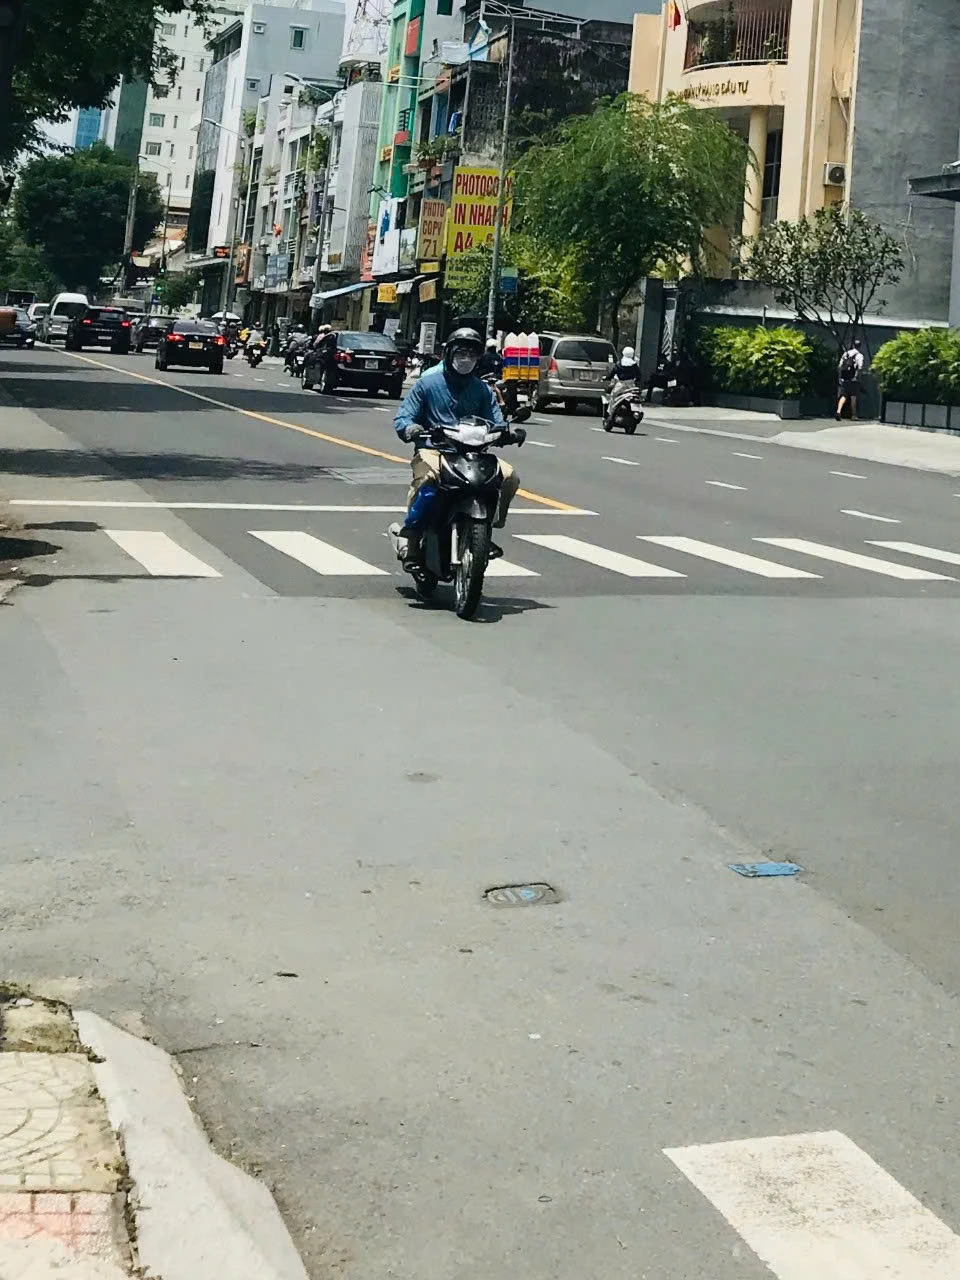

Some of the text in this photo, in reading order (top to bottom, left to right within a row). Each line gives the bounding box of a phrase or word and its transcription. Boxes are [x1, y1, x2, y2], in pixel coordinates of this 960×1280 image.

[455, 173, 512, 198] PHOTOCOY
[422, 201, 445, 218] PHOTO
[454, 203, 466, 225] IN
[422, 221, 443, 236] COPY
[422, 239, 438, 258] 71
[453, 231, 474, 253] A4
